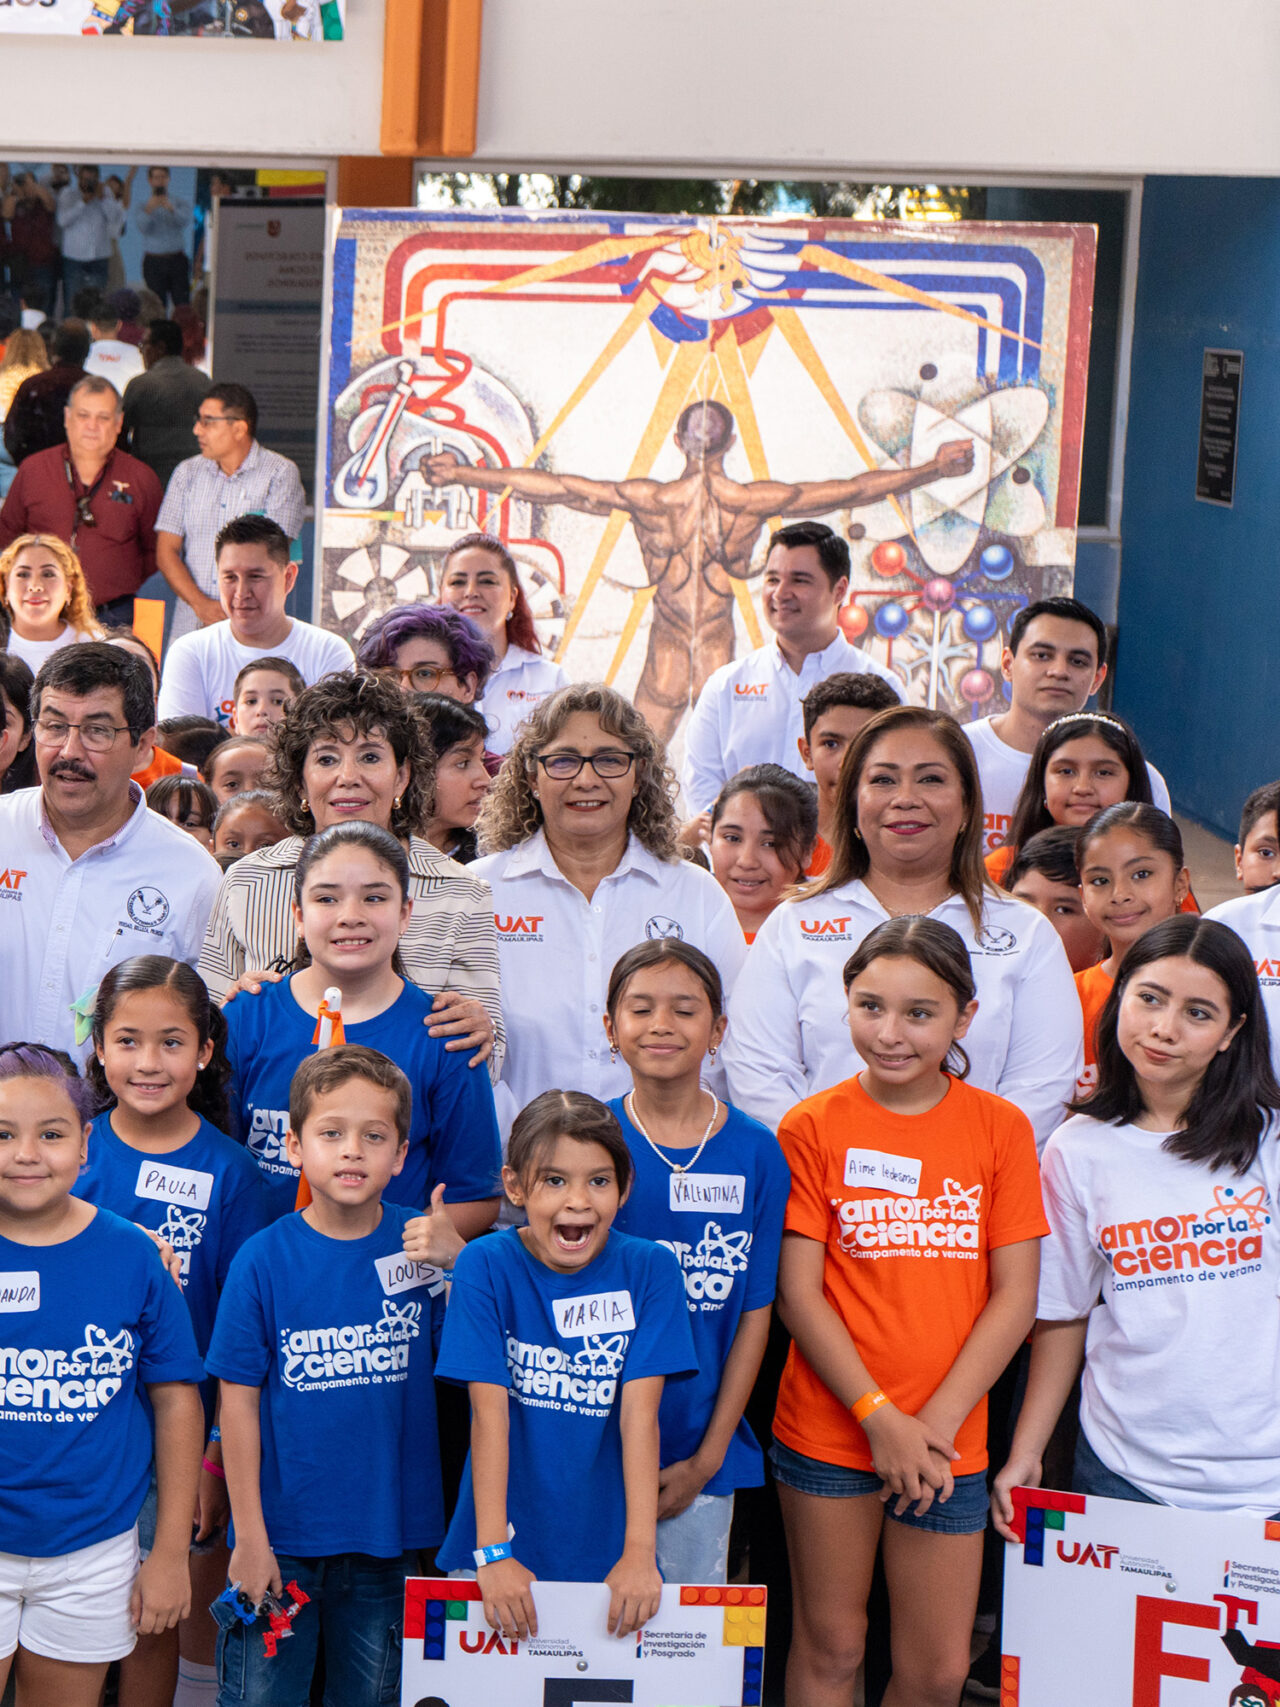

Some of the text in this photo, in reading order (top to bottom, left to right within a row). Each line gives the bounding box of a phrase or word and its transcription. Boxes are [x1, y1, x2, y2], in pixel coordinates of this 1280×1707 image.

[734, 683, 769, 696] UAT
[494, 913, 545, 933] UAT
[800, 917, 852, 934] UAT
[144, 1170, 197, 1201] PAULA
[673, 1182, 740, 1205] VALENTINA
[839, 1197, 931, 1223] amor
[855, 1220, 979, 1248] ciencia
[1100, 1213, 1248, 1252] amor por la
[849, 1247, 979, 1262] Campamento de verano
[1112, 1235, 1263, 1277] ciencia
[388, 1261, 436, 1288] LOUIS
[1198, 1270, 1216, 1283] de
[1219, 1263, 1263, 1281] verano
[563, 1299, 629, 1329] MARIA
[288, 1323, 373, 1355] amor
[303, 1344, 409, 1379] ciencia
[506, 1336, 571, 1373] amor
[297, 1376, 370, 1392] Campamento
[372, 1374, 383, 1384] de
[511, 1364, 618, 1406] ciencia
[55, 1408, 79, 1423] de
[562, 1400, 578, 1414] de
[578, 1405, 611, 1419] veran
[1056, 1539, 1120, 1570] UAT
[1120, 1565, 1172, 1579] TAMAULIPAS
[527, 1637, 570, 1646] Universidad
[643, 1630, 708, 1640] Secretaría de
[643, 1640, 706, 1650] Investigación
[527, 1643, 577, 1651] Autónoma de
[527, 1649, 584, 1658] TAMAULIPAS
[643, 1649, 696, 1659] y Posgrado
